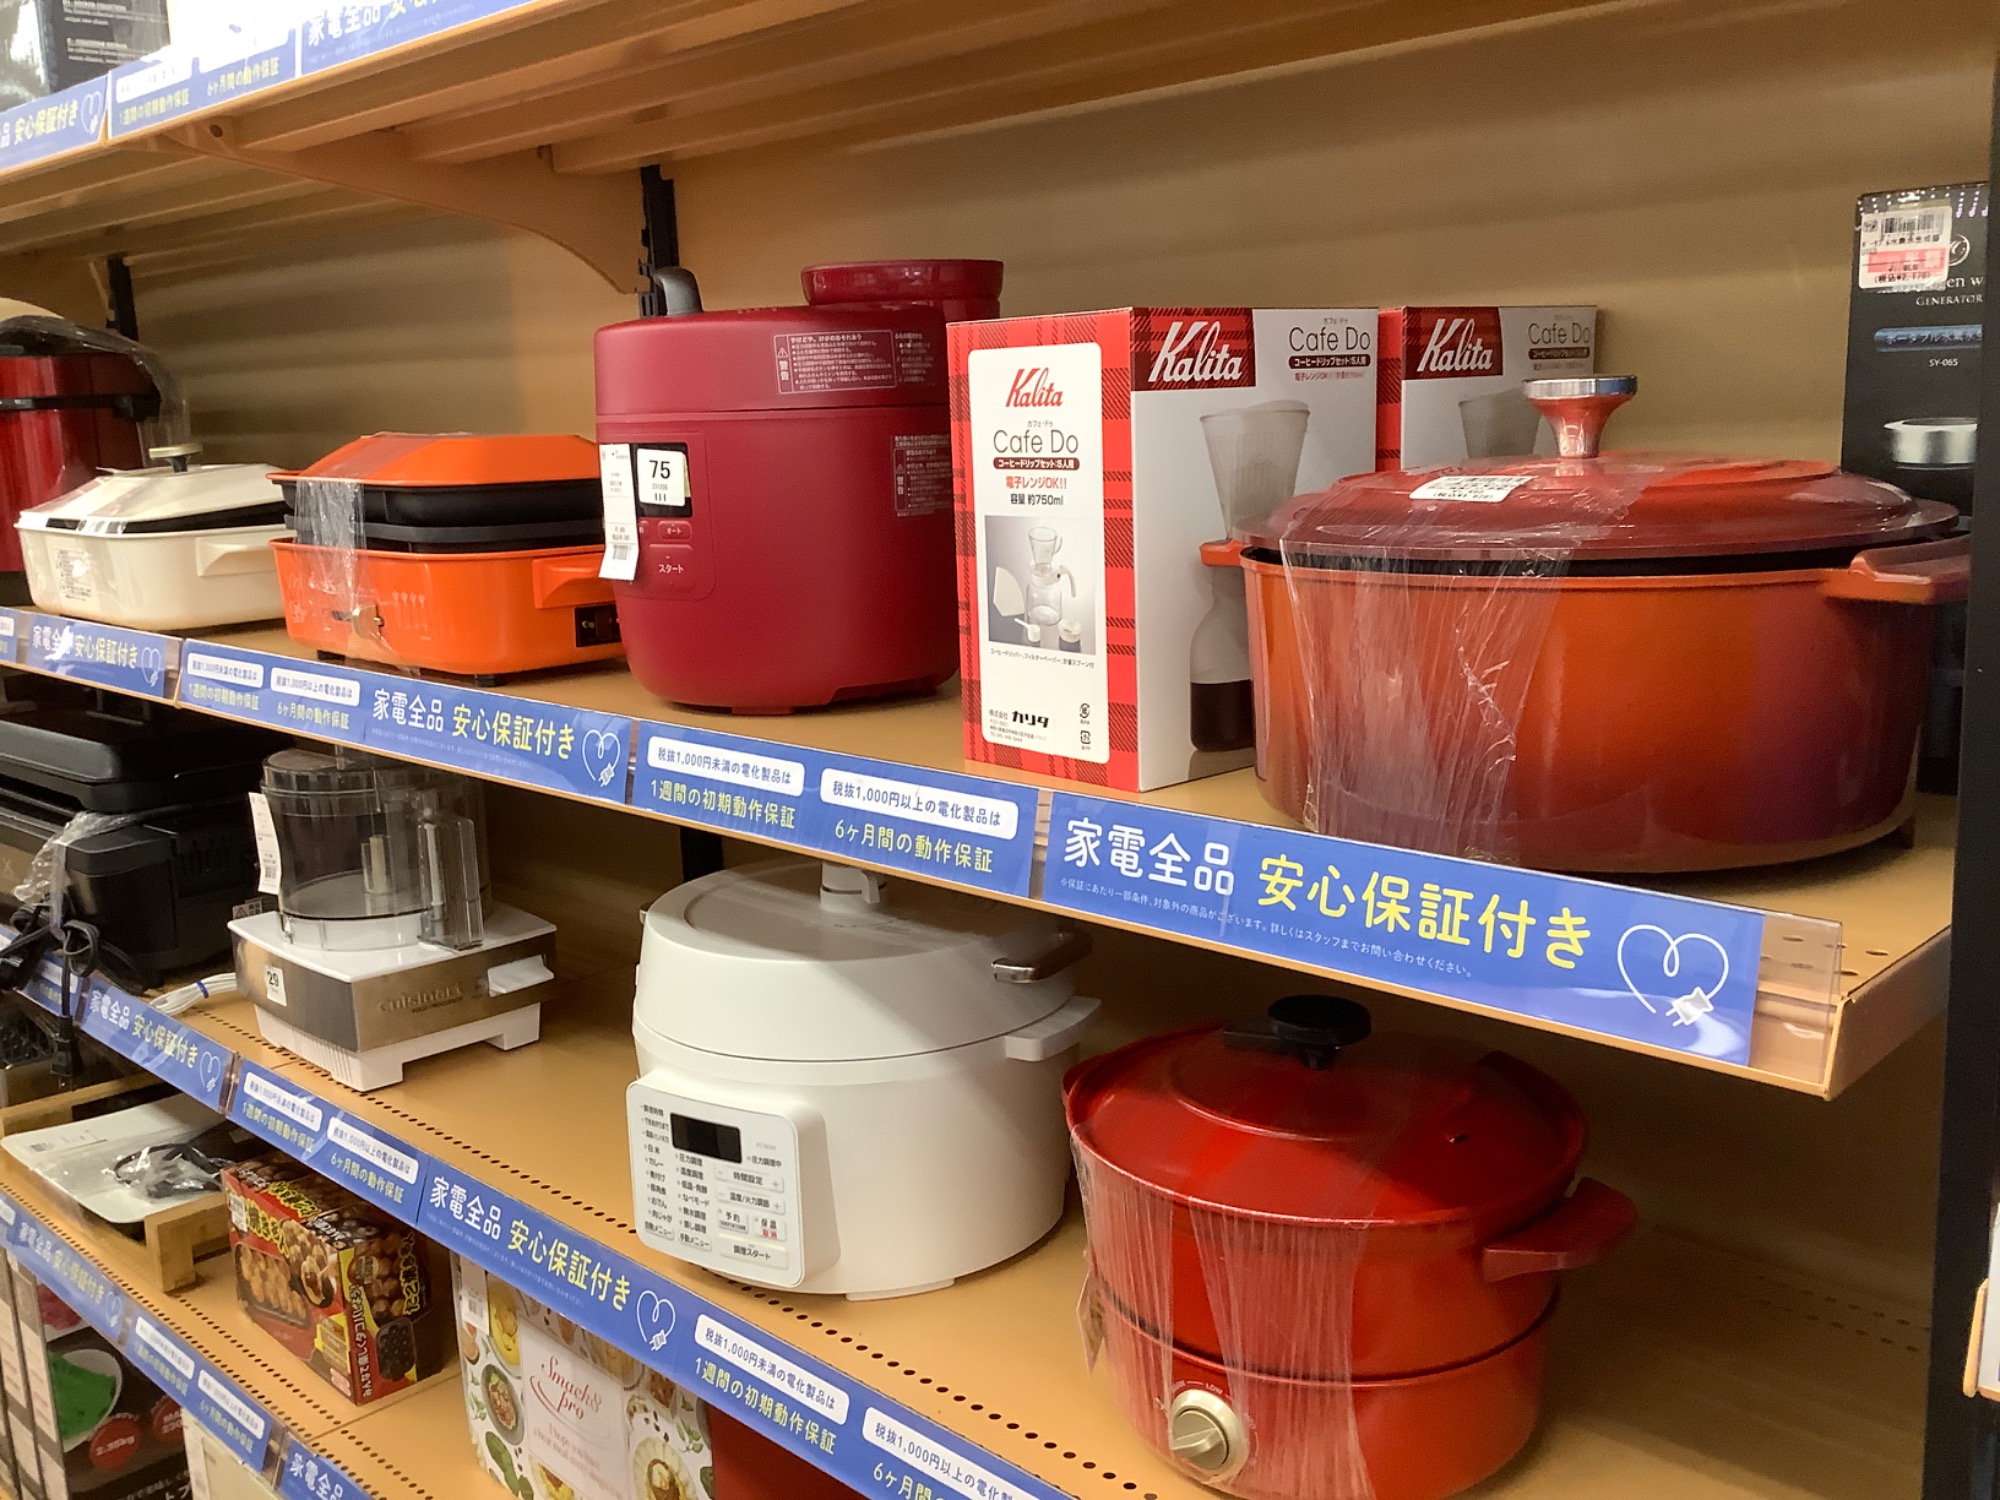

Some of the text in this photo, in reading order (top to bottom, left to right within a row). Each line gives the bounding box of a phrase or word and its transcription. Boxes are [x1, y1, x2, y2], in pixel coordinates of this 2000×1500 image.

[1148, 320, 1243, 383] Kalita
[1289, 326, 1371, 351] Cafe Do
[1417, 317, 1493, 373] Kalita
[1528, 322, 1590, 345] Cafe Do
[1005, 367, 1064, 408] Kalita
[993, 429, 1080, 454] Cafe Do
[648, 460, 671, 480] 75
[1006, 475, 1067, 490] 電子レンジOK!!
[658, 564, 685, 575] スタート
[74, 634, 138, 671] 安心保証付き
[372, 688, 445, 733] 家電全品
[451, 702, 576, 761] 安心保証付き
[1012, 710, 1049, 728] カリタ
[657, 745, 793, 785] 税抜1,000円未満の電化製品は
[650, 777, 796, 831] 1週間の初期動作保証
[831, 779, 1002, 827] 税抜1,000円以上の電化製品は
[834, 821, 994, 874] 6ヶ月間の動作保証
[1063, 817, 1593, 970] 家電全品 安心保証付き
[266, 970, 279, 987] 29
[90, 989, 199, 1069] 家電全品 安心保証付き
[733, 1171, 763, 1186] 時間設定
[429, 1176, 502, 1241] 家電全品
[507, 1219, 631, 1312] 安心保証付き
[733, 1245, 771, 1261] 調理スタート
[704, 1326, 836, 1411] 税抜1,000円未満の電化製品は
[1205, 1382, 1224, 1395] LOW
[695, 1356, 838, 1456] 1週間の初期動作保証
